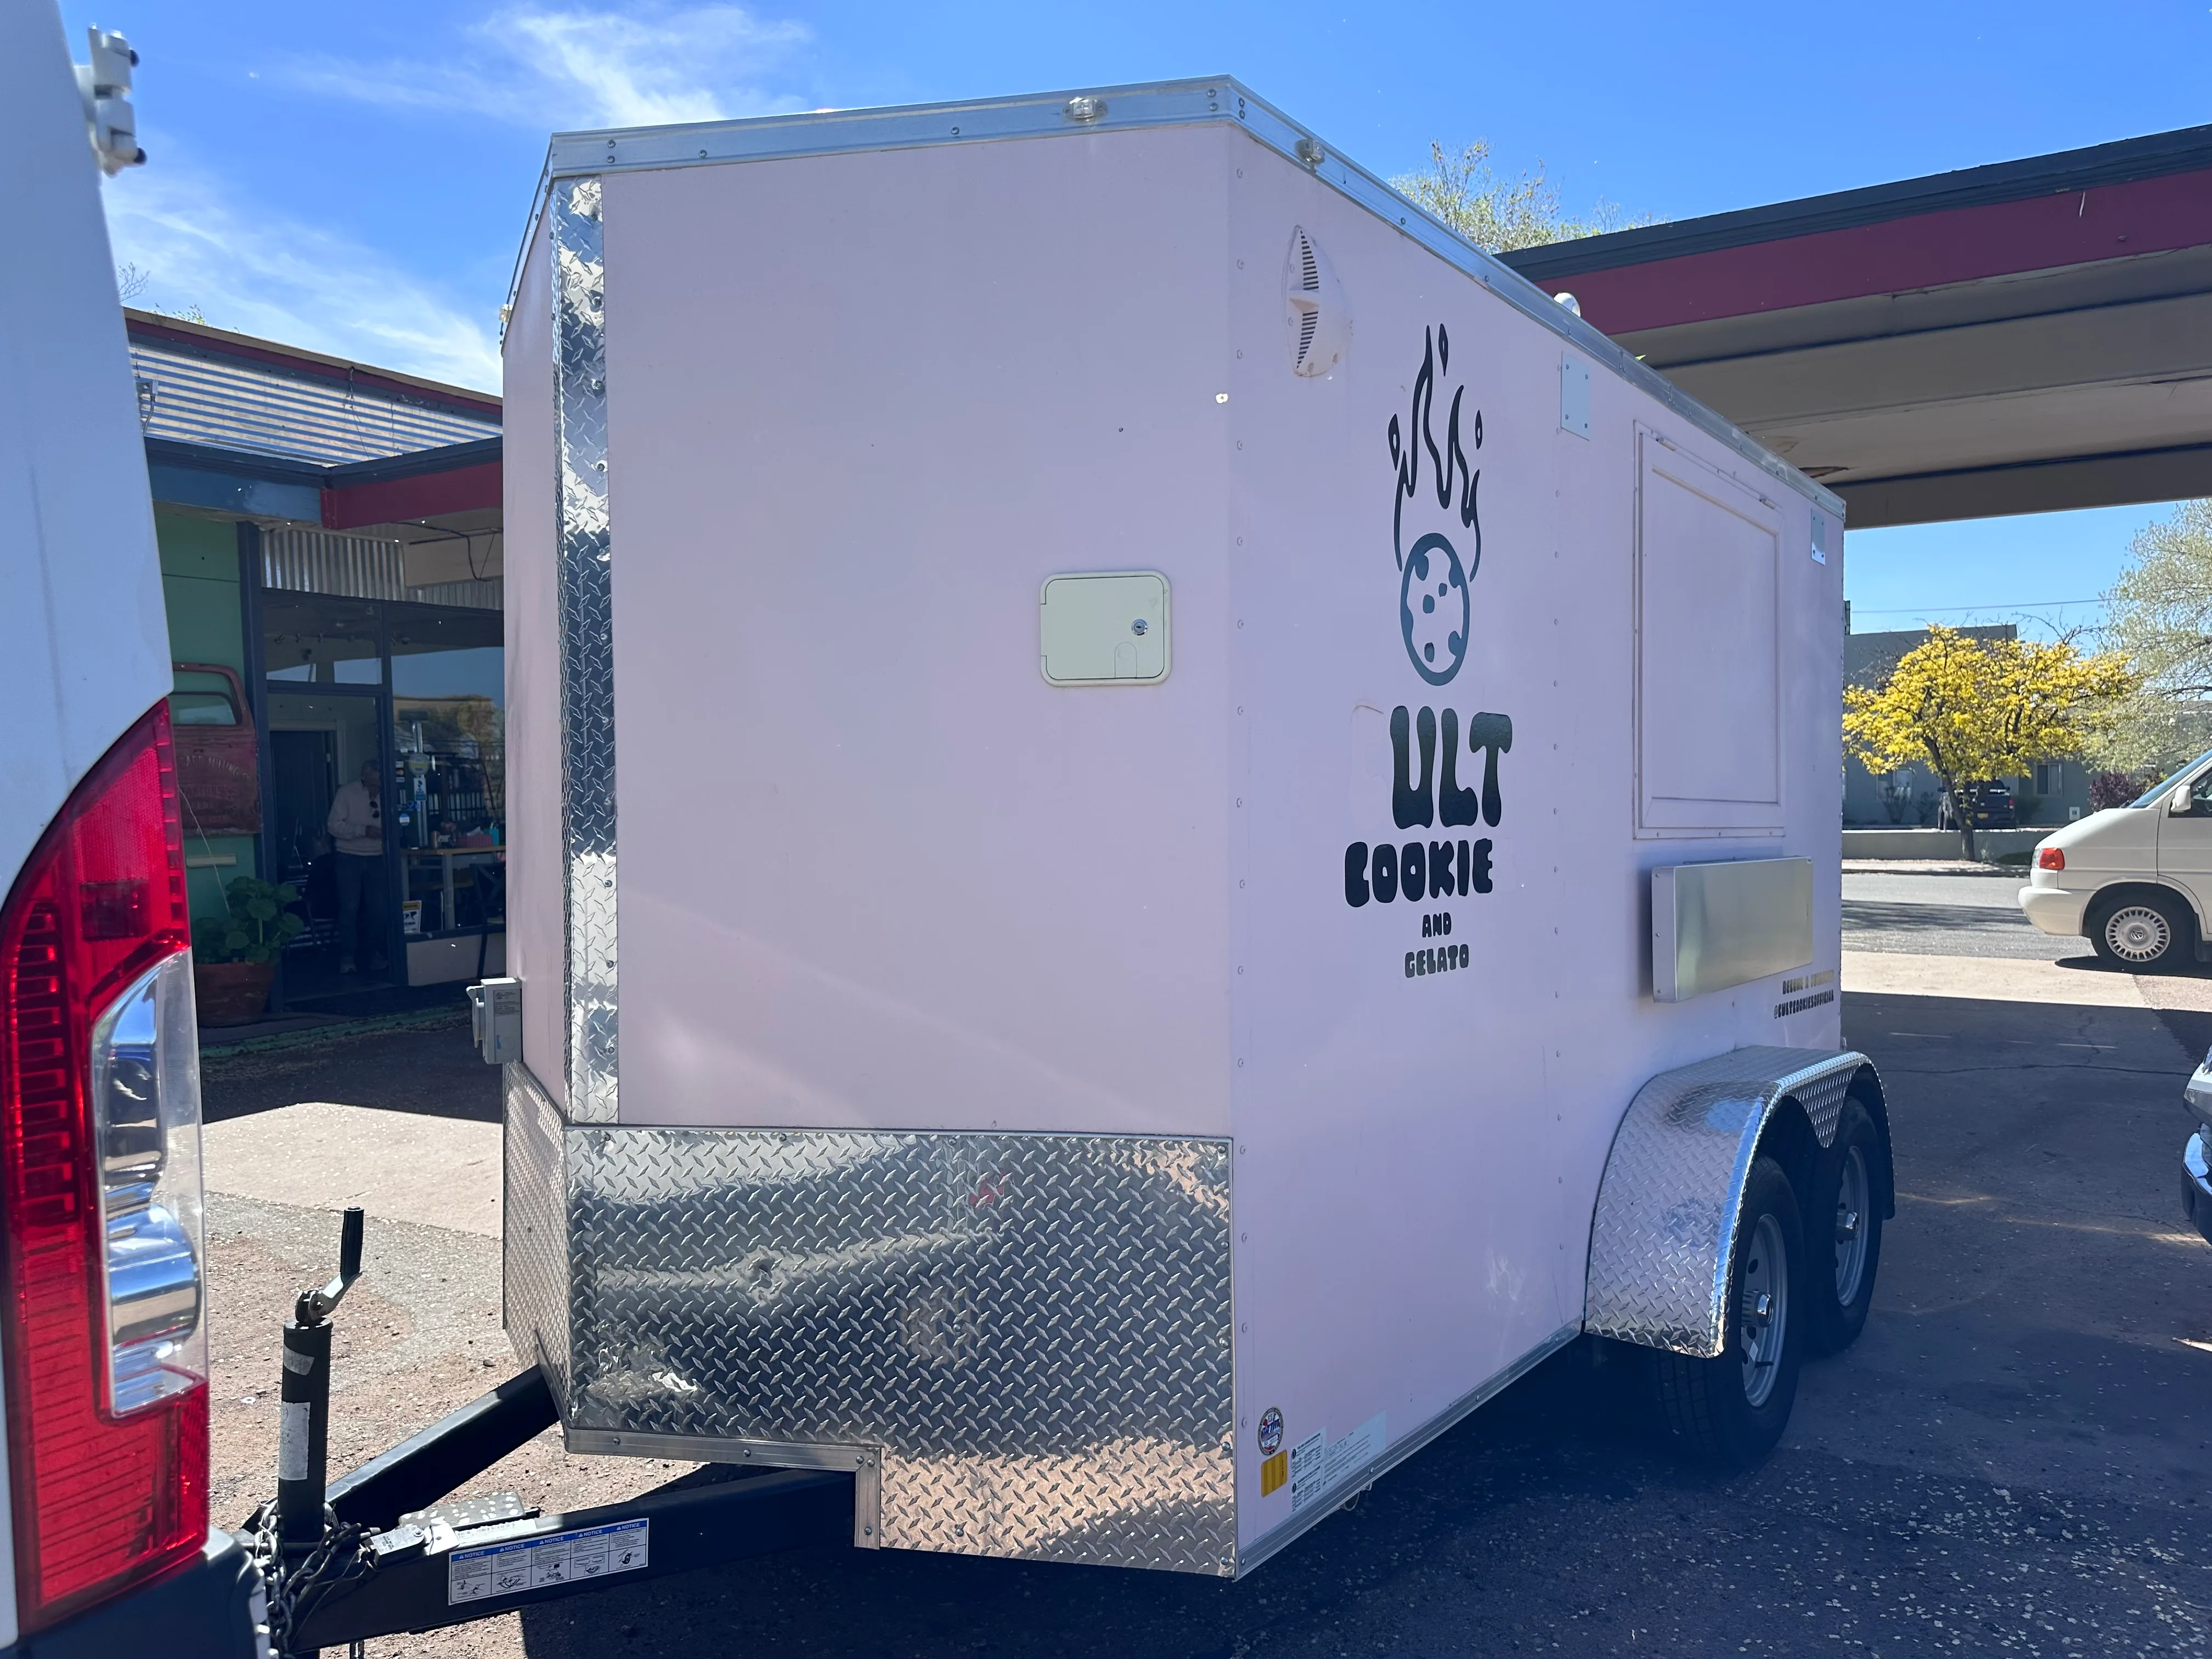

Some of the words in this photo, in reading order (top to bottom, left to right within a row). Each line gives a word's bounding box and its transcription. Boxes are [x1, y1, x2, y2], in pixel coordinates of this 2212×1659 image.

[1390, 706, 1513, 830] ULT
[1345, 838, 1493, 907] COOKIE
[1422, 912, 1452, 938] AND
[1405, 944, 1469, 978] GELATO
[464, 1550, 485, 1559] NOTICE
[505, 1543, 525, 1551] NOTICE
